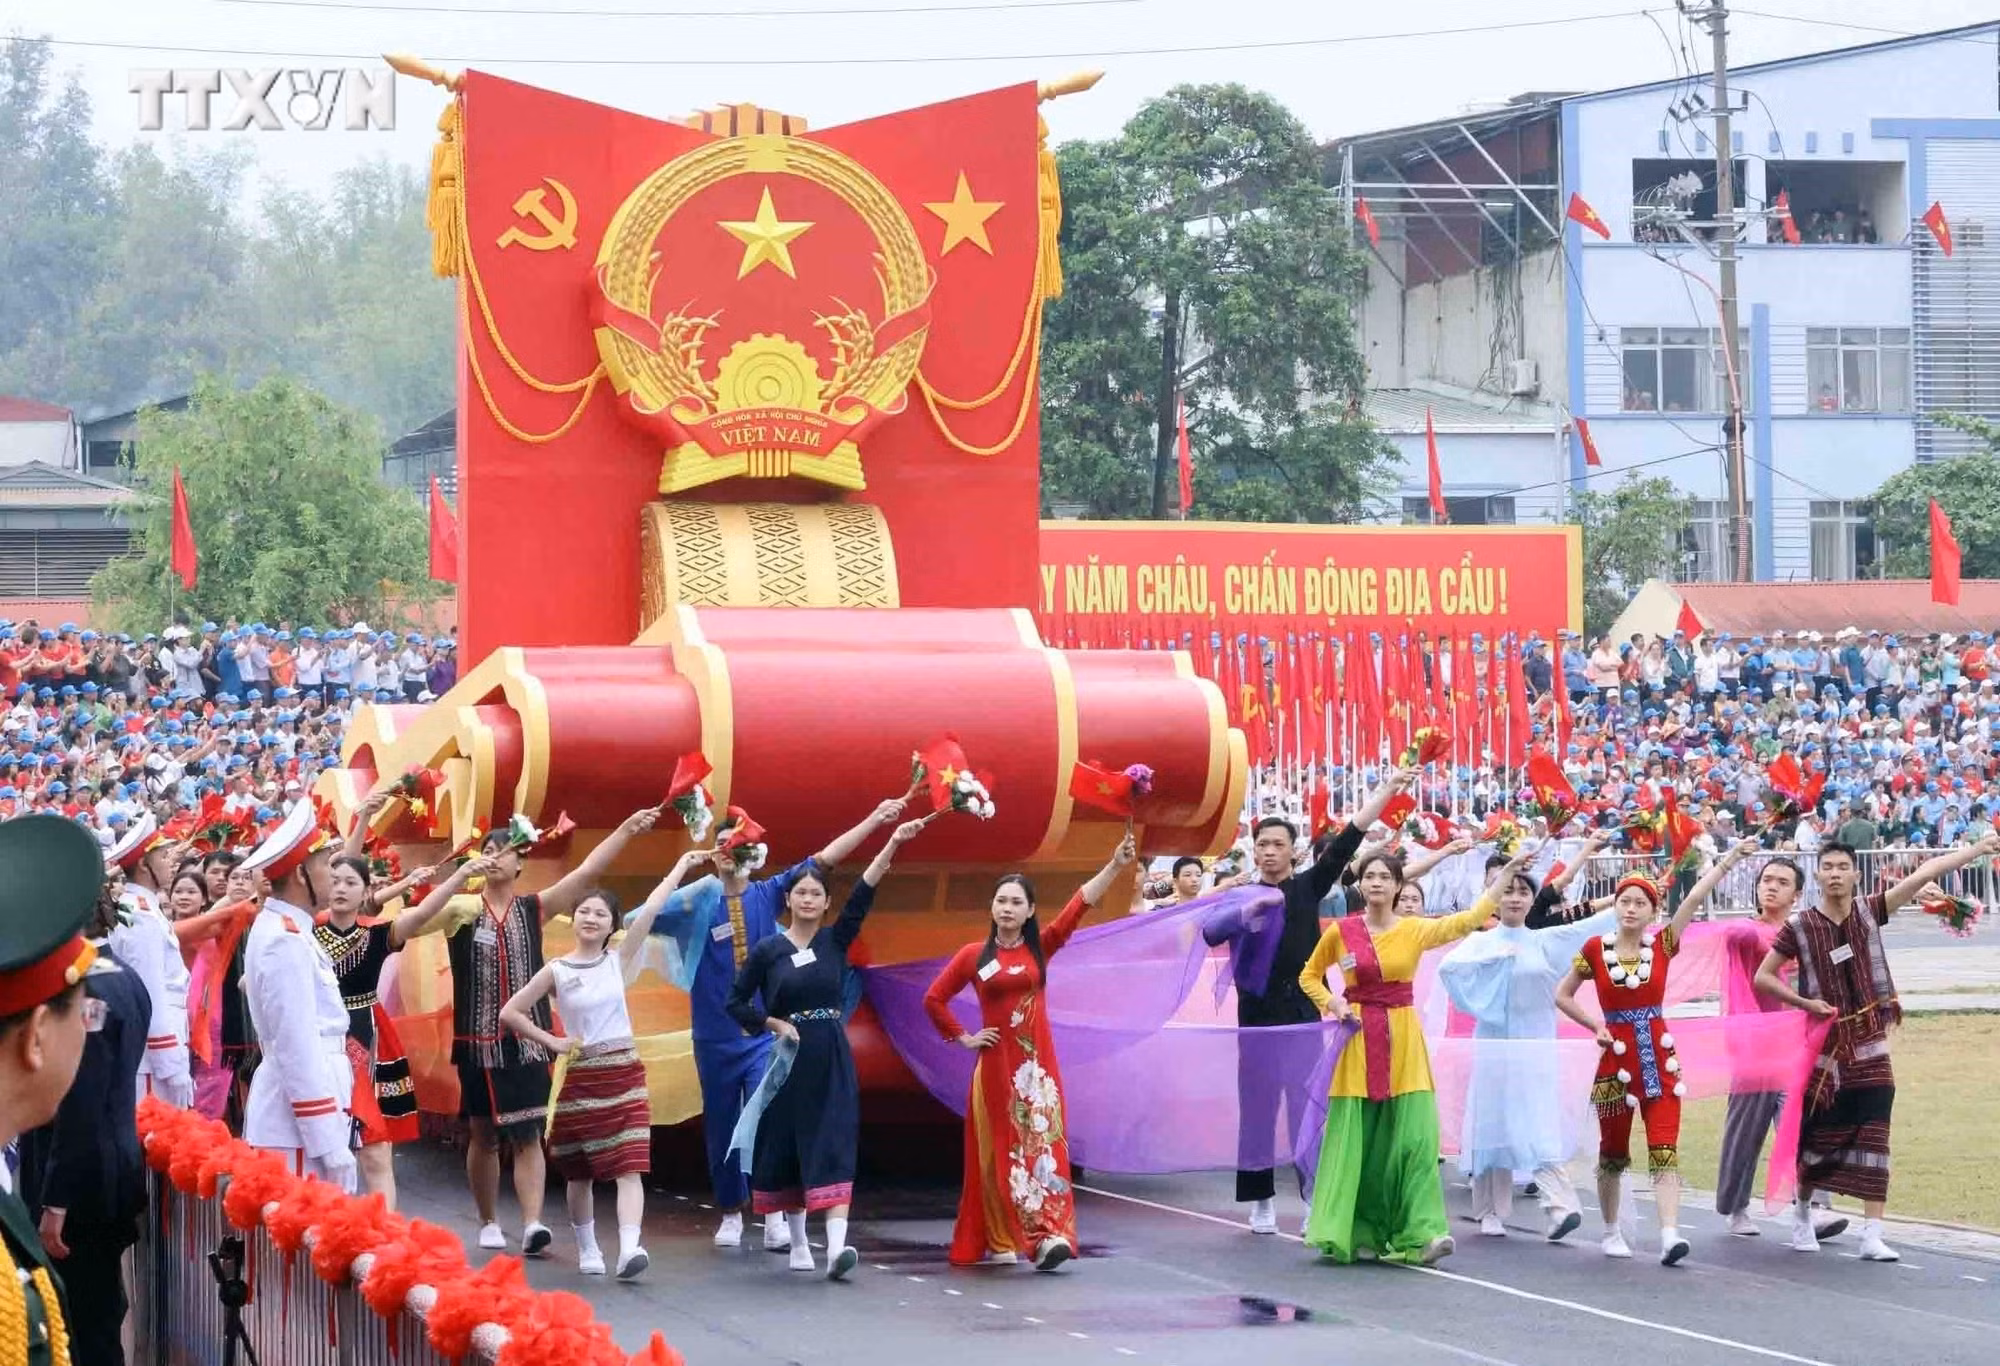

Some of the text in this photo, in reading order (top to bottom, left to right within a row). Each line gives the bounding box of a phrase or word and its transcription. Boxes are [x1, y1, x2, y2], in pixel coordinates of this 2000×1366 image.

[721, 423, 821, 447] VIỆT NAM
[1038, 564, 1057, 614] Y
[1065, 554, 1128, 614] NĂM
[1137, 553, 1217, 620] CHÂU,
[1225, 549, 1297, 615] CHẤN
[1304, 555, 1378, 627] ĐỘNG
[1385, 567, 1433, 626] ĐỊA
